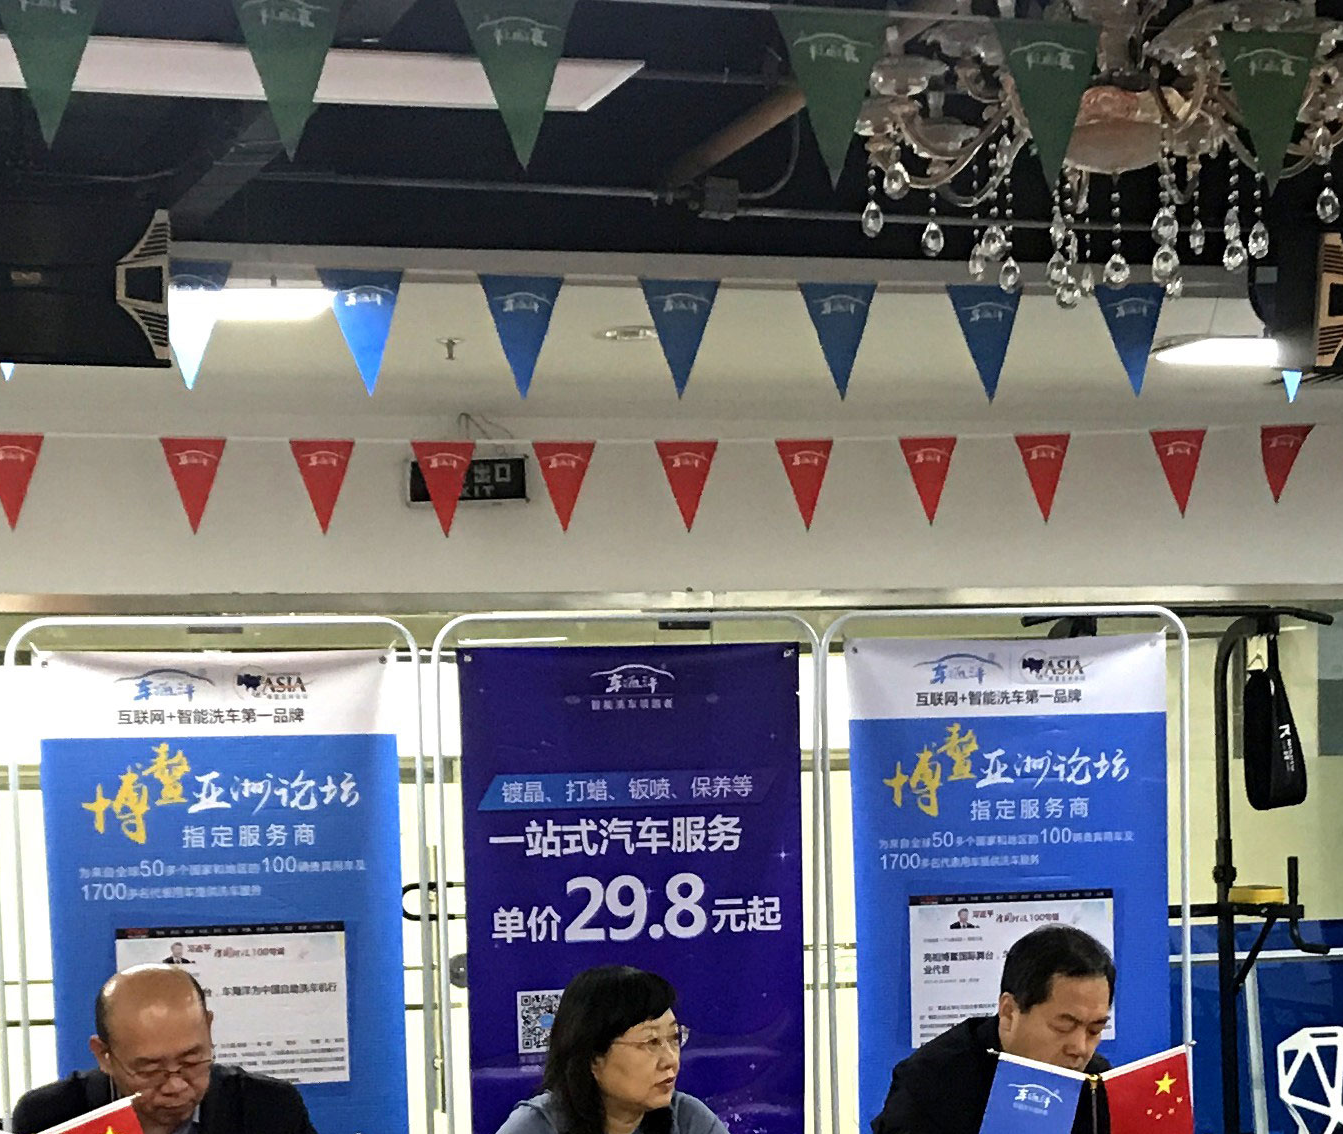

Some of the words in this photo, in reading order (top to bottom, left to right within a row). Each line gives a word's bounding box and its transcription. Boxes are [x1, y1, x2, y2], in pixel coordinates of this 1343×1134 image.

[915, 688, 1082, 708] 互联网+智能洗车第一品牌
[117, 707, 305, 725] 互联网+智能洗车第一品牌
[970, 797, 1090, 822] 指定服务商
[182, 823, 316, 849] 指定服务商
[489, 814, 743, 858] 一站式汽车服务
